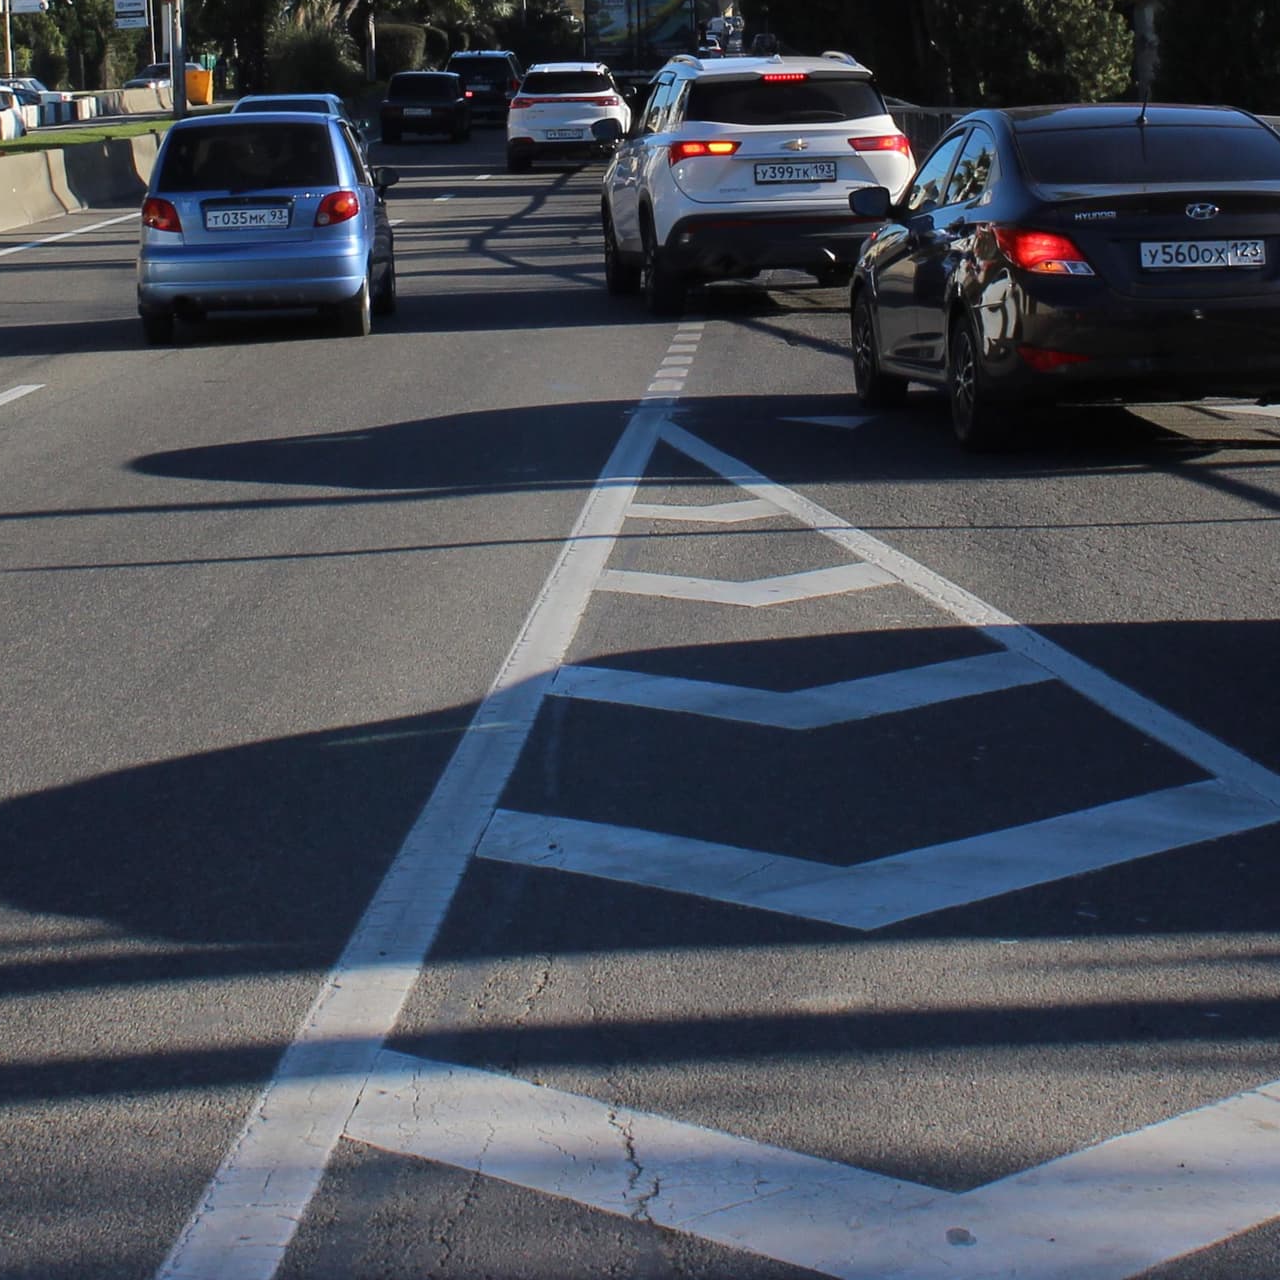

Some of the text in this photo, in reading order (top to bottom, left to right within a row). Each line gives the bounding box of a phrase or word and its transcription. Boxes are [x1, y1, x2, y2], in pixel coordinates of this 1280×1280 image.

[760, 164, 832, 180] У399ТК 193
[212, 210, 284, 225] Т035МК 93
[1147, 241, 1260, 265] У560ОХ 123
